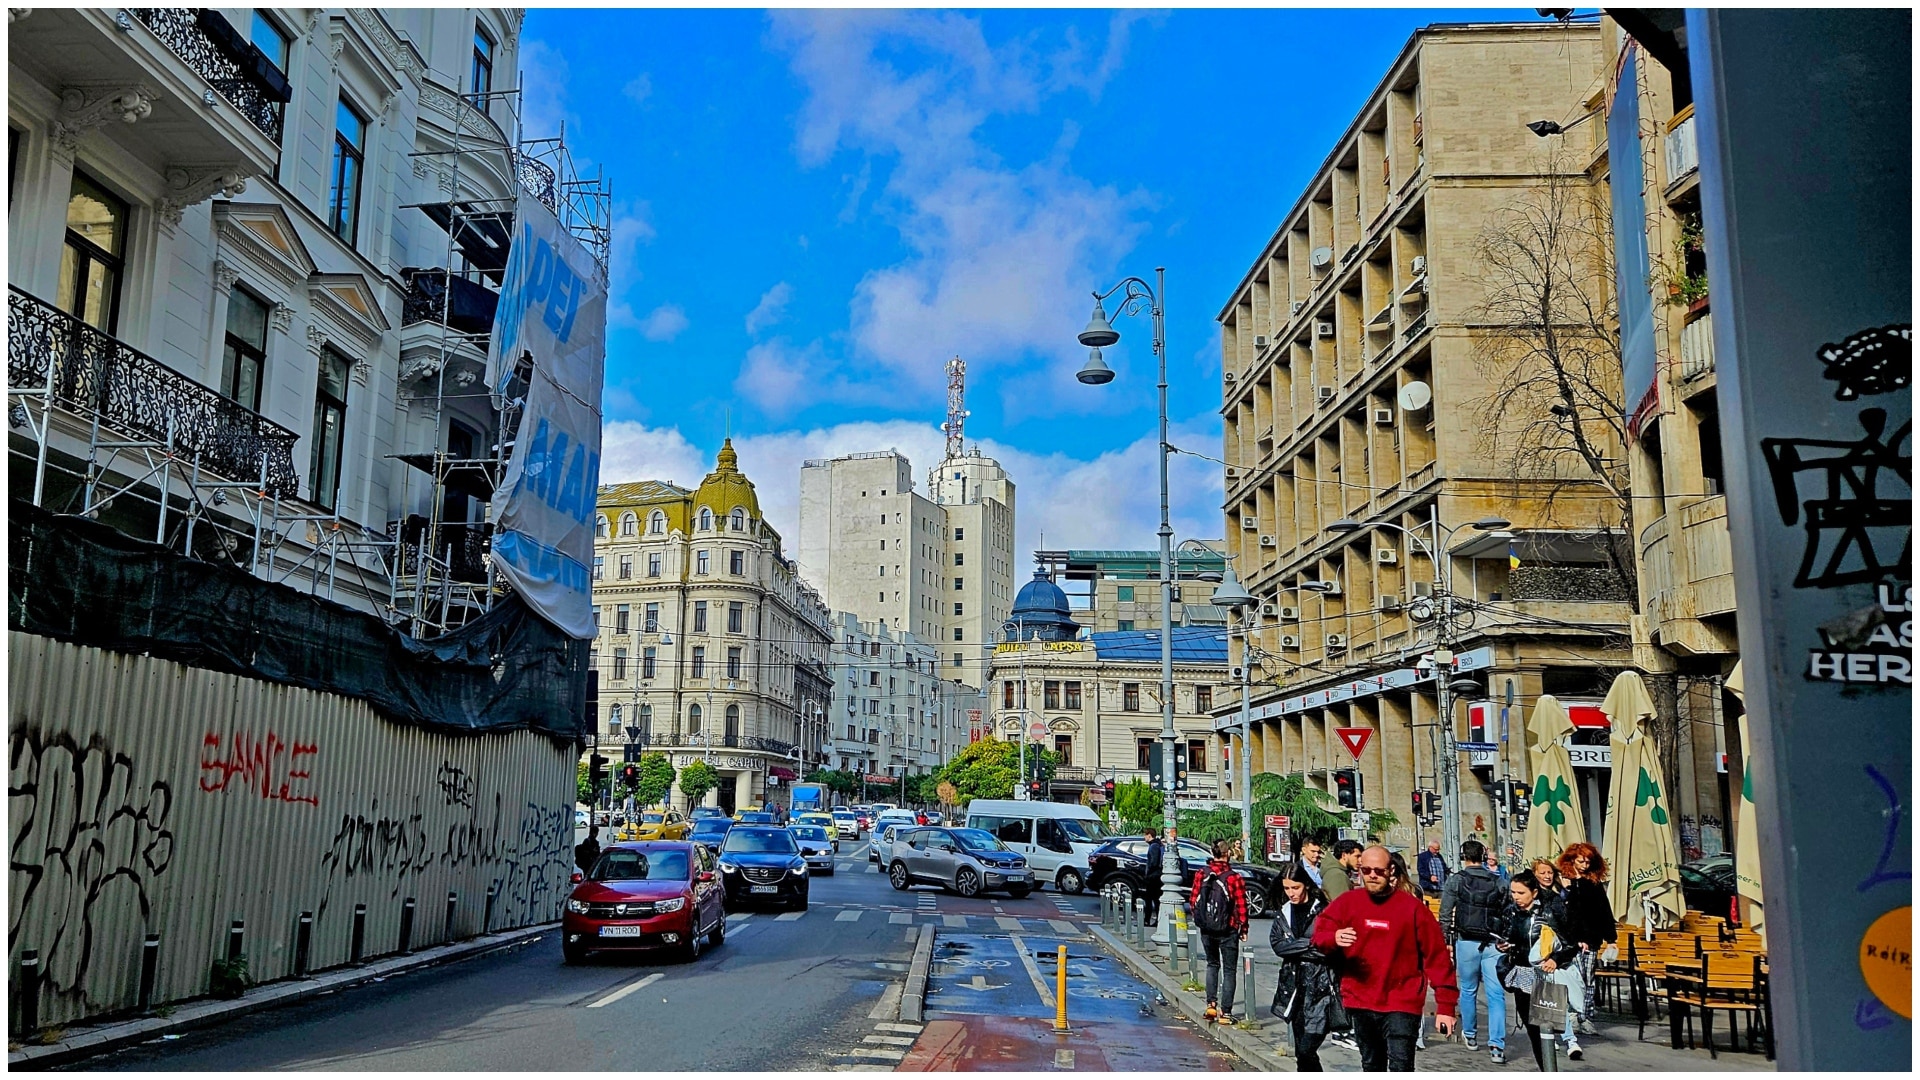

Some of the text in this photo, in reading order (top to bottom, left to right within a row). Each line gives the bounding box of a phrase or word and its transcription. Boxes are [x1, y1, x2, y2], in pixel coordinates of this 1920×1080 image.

[526, 236, 583, 344] PEI
[1828, 620, 1912, 648] AS
[1461, 657, 1473, 667] BRD
[680, 755, 723, 766] HOEL
[1628, 862, 1663, 886] rlsberg
[603, 927, 614, 935] VN
[1540, 999, 1558, 1008] NYX
